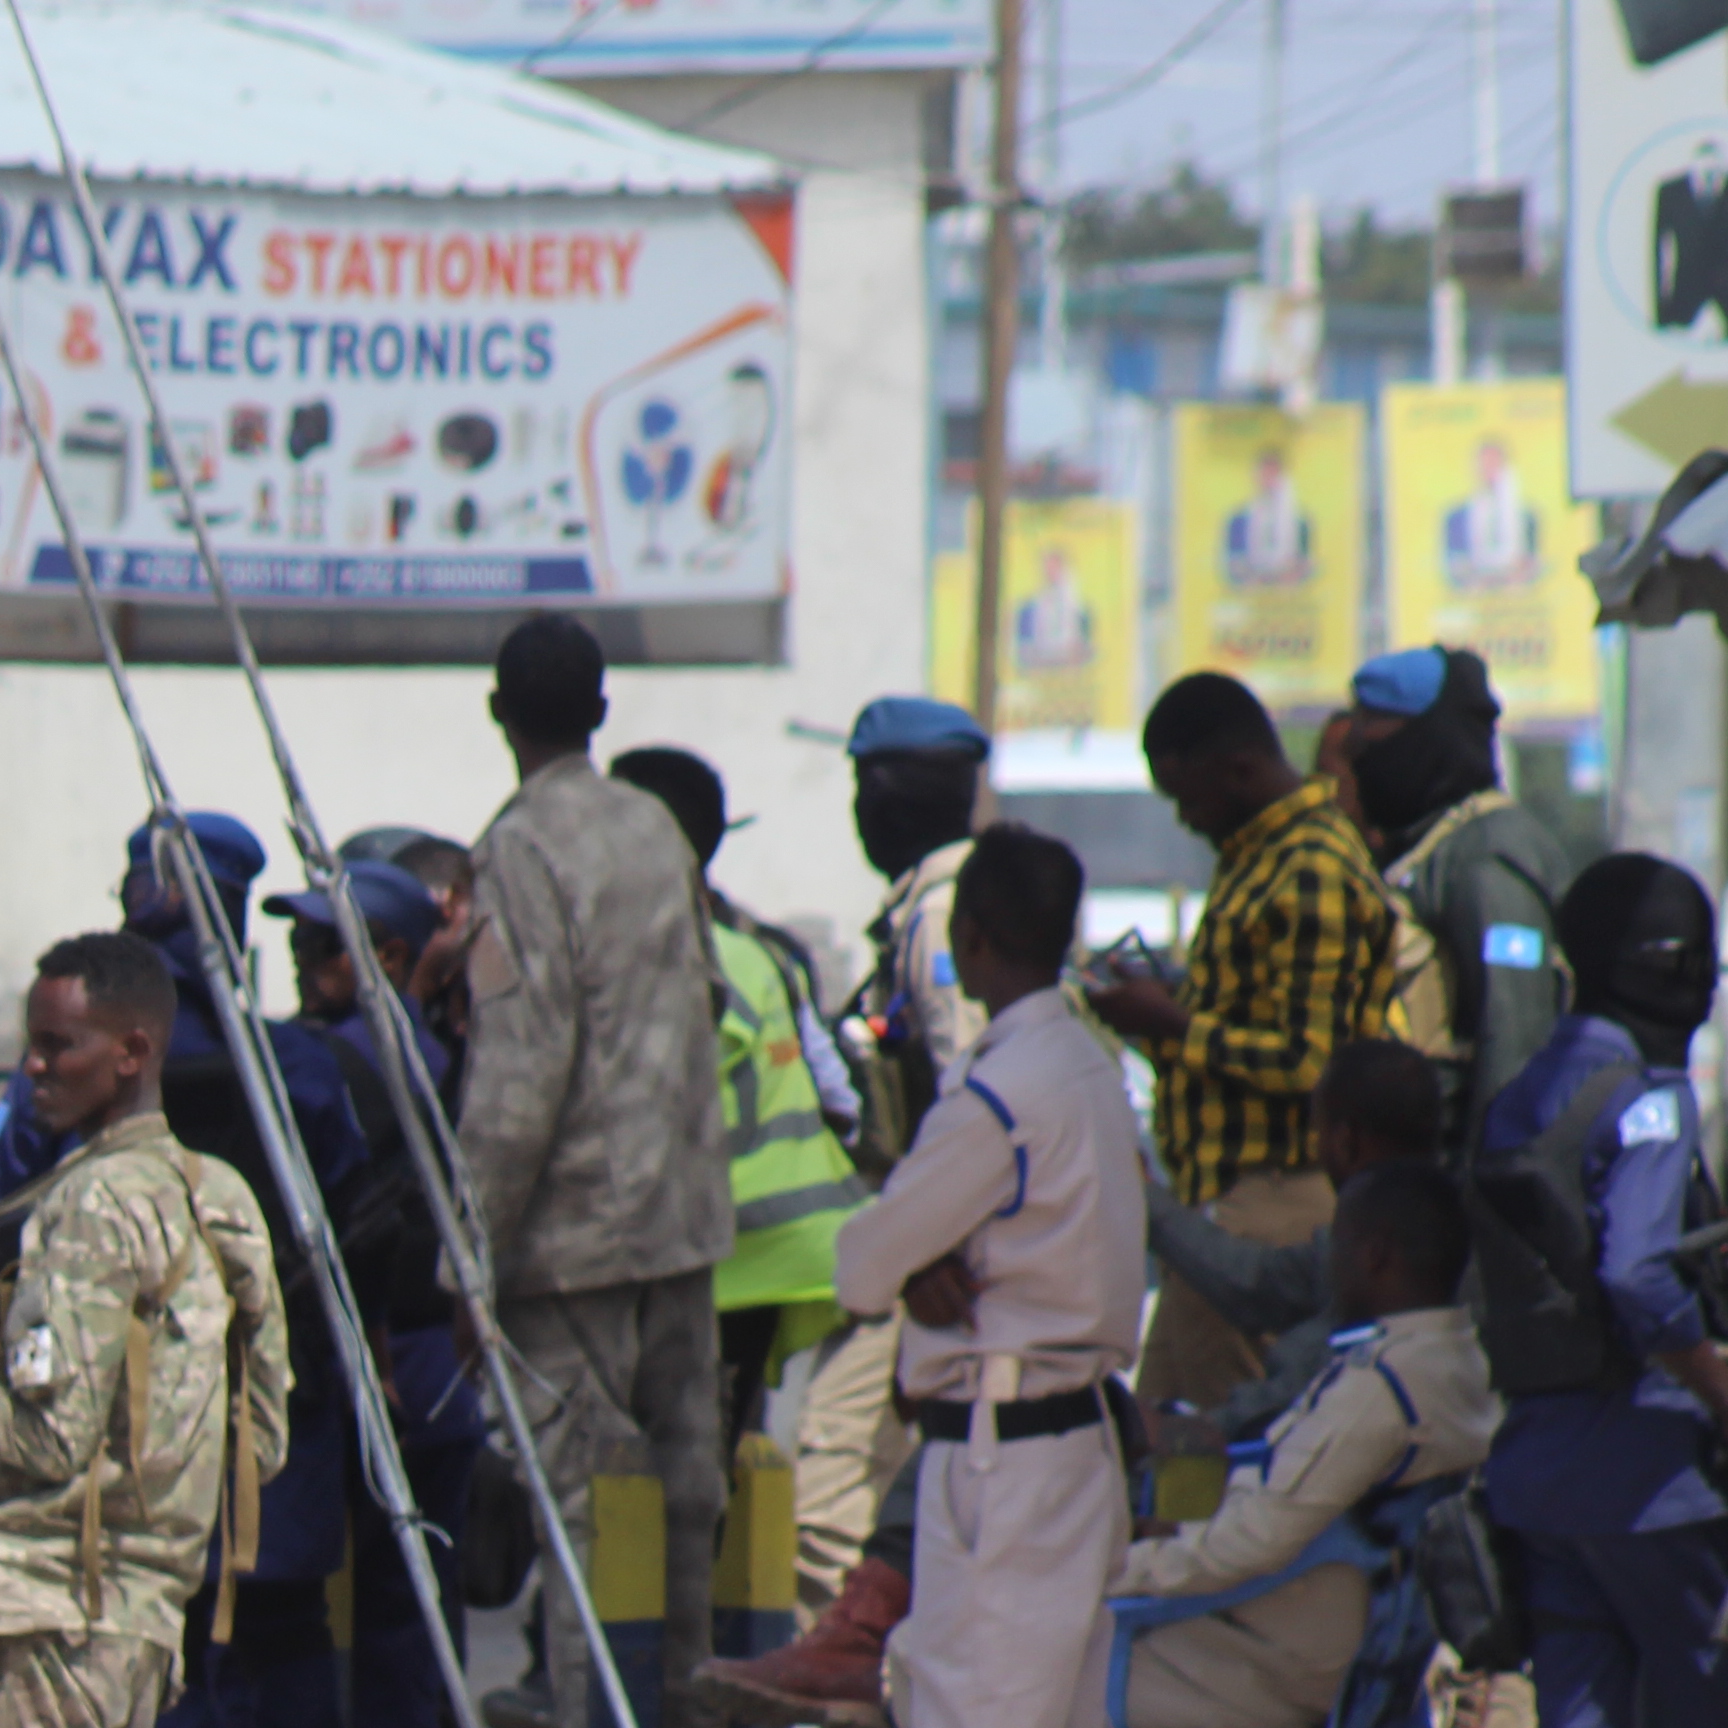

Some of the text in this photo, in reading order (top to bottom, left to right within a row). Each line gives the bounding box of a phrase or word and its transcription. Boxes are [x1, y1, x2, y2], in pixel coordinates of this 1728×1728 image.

[259, 229, 642, 298] STATIONERY
[61, 303, 554, 381] & ELECTRONICS
